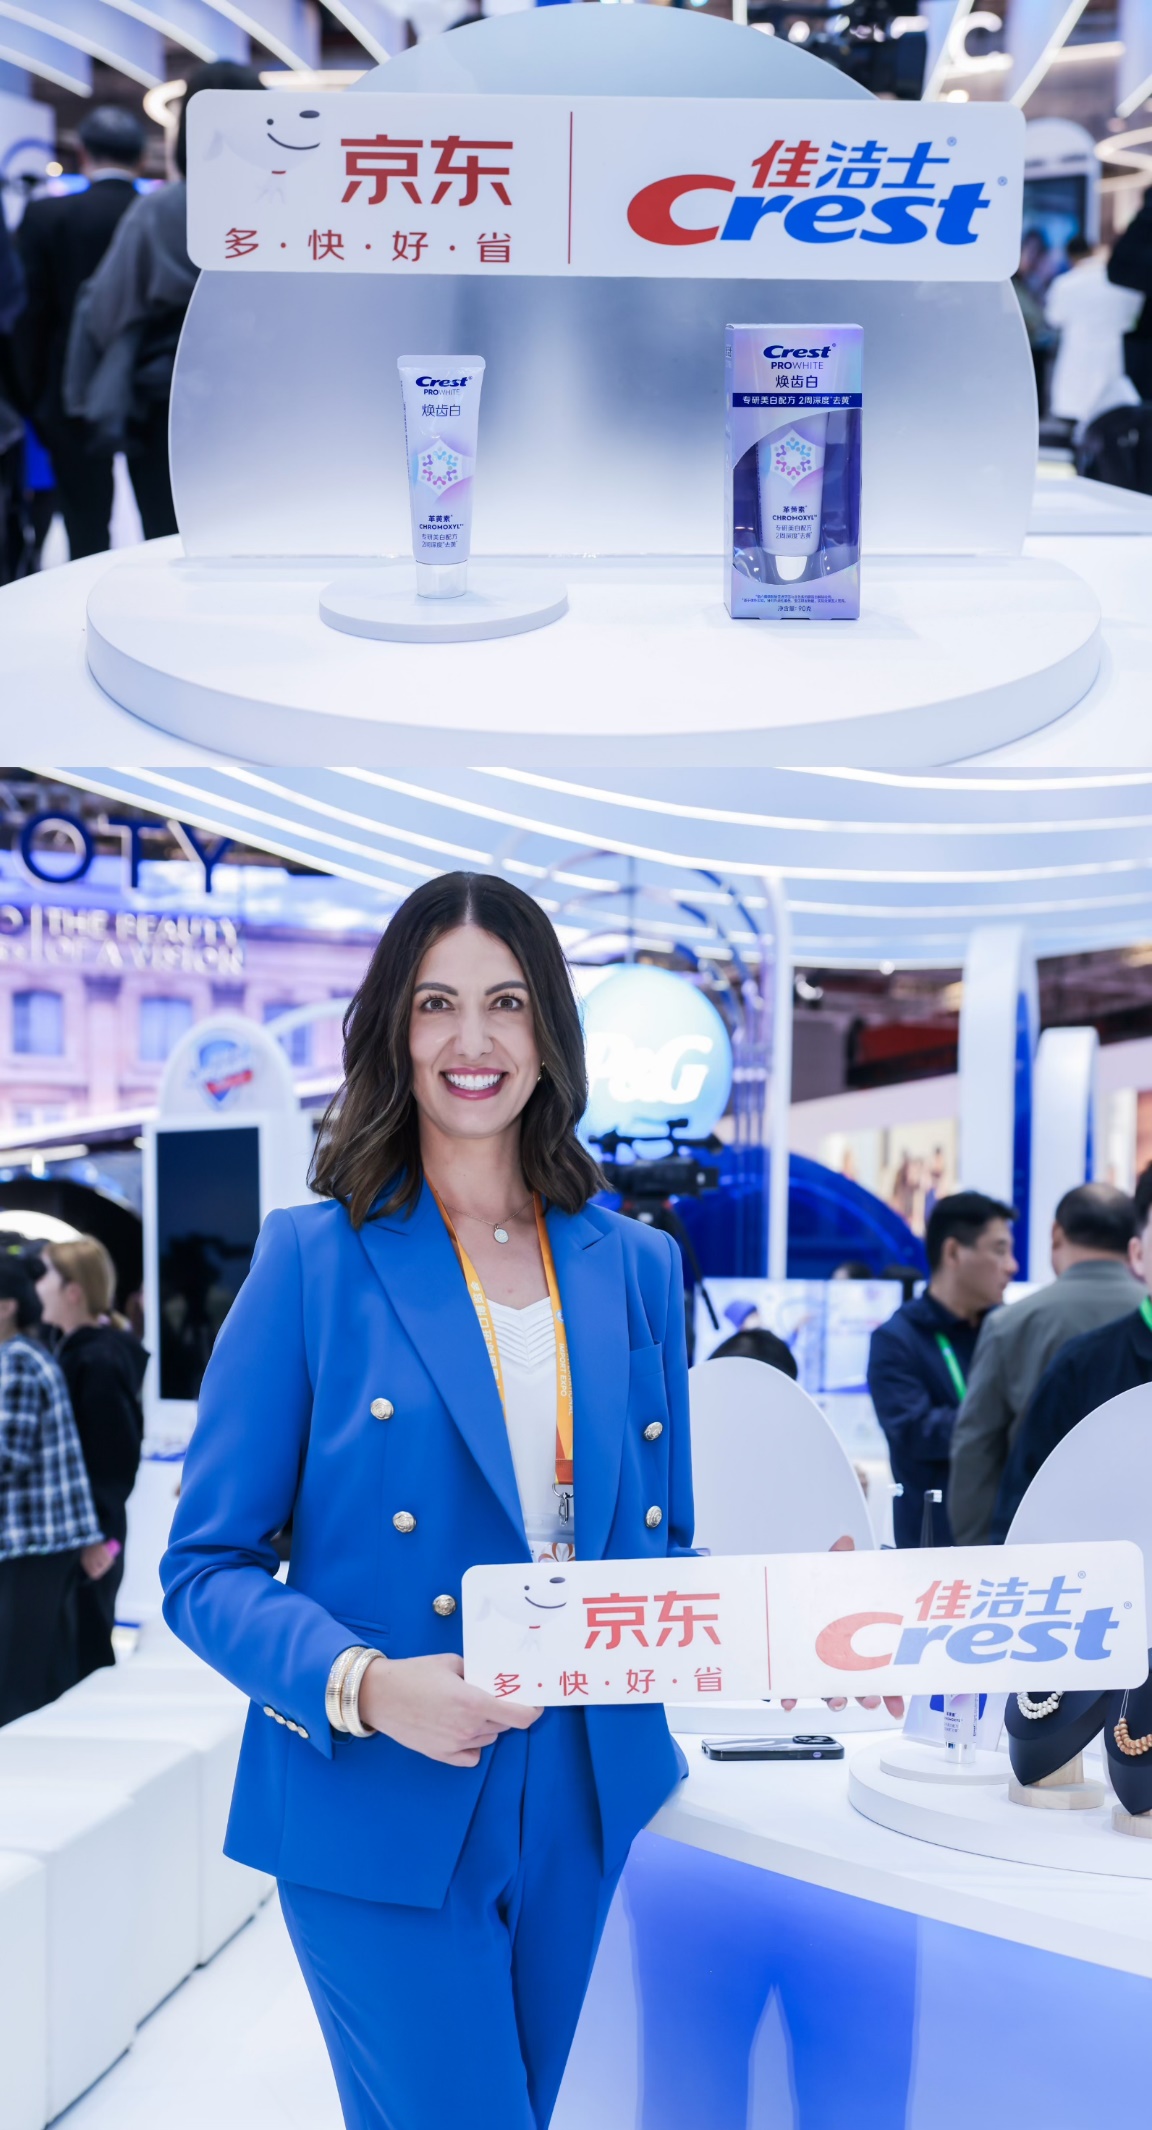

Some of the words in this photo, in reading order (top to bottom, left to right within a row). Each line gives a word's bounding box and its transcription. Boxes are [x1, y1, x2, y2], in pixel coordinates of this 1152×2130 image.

[341, 134, 513, 206] 京东
[751, 140, 950, 189] 佳洁士
[627, 174, 991, 245] Crest
[763, 345, 831, 358] Crest
[415, 376, 468, 387] Crest
[743, 396, 796, 405] 专研美白配方
[775, 375, 818, 388] 焕齿白
[422, 404, 460, 417] 焕齿白
[0, 811, 236, 893] OTY
[582, 1591, 722, 1650] 京东
[915, 1575, 1082, 1621] 佳洁士
[815, 1607, 1120, 1671] Crest
